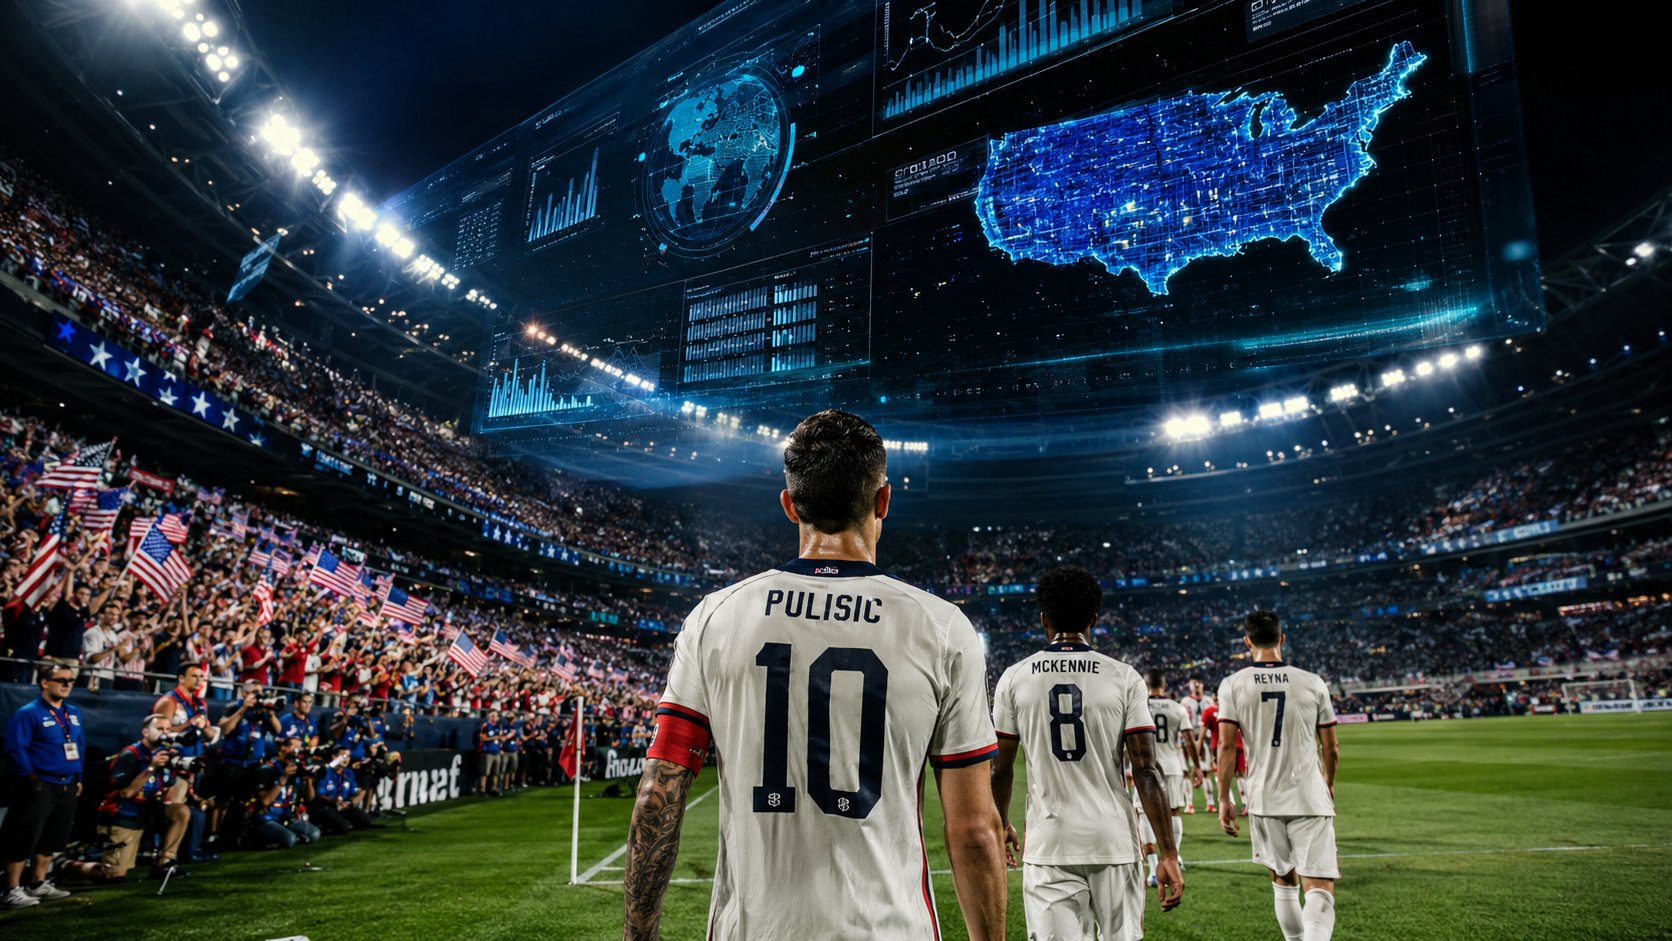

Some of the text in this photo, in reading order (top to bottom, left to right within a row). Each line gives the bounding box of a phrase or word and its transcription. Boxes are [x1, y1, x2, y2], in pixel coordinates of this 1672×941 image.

[764, 590, 883, 624] PULISIC
[1031, 659, 1100, 675] MCKENNIE
[1254, 673, 1289, 684] REYNA
[753, 642, 889, 820] 10
[1048, 683, 1087, 762] 8
[1155, 713, 1169, 743] 8
[1261, 691, 1286, 747] 7
